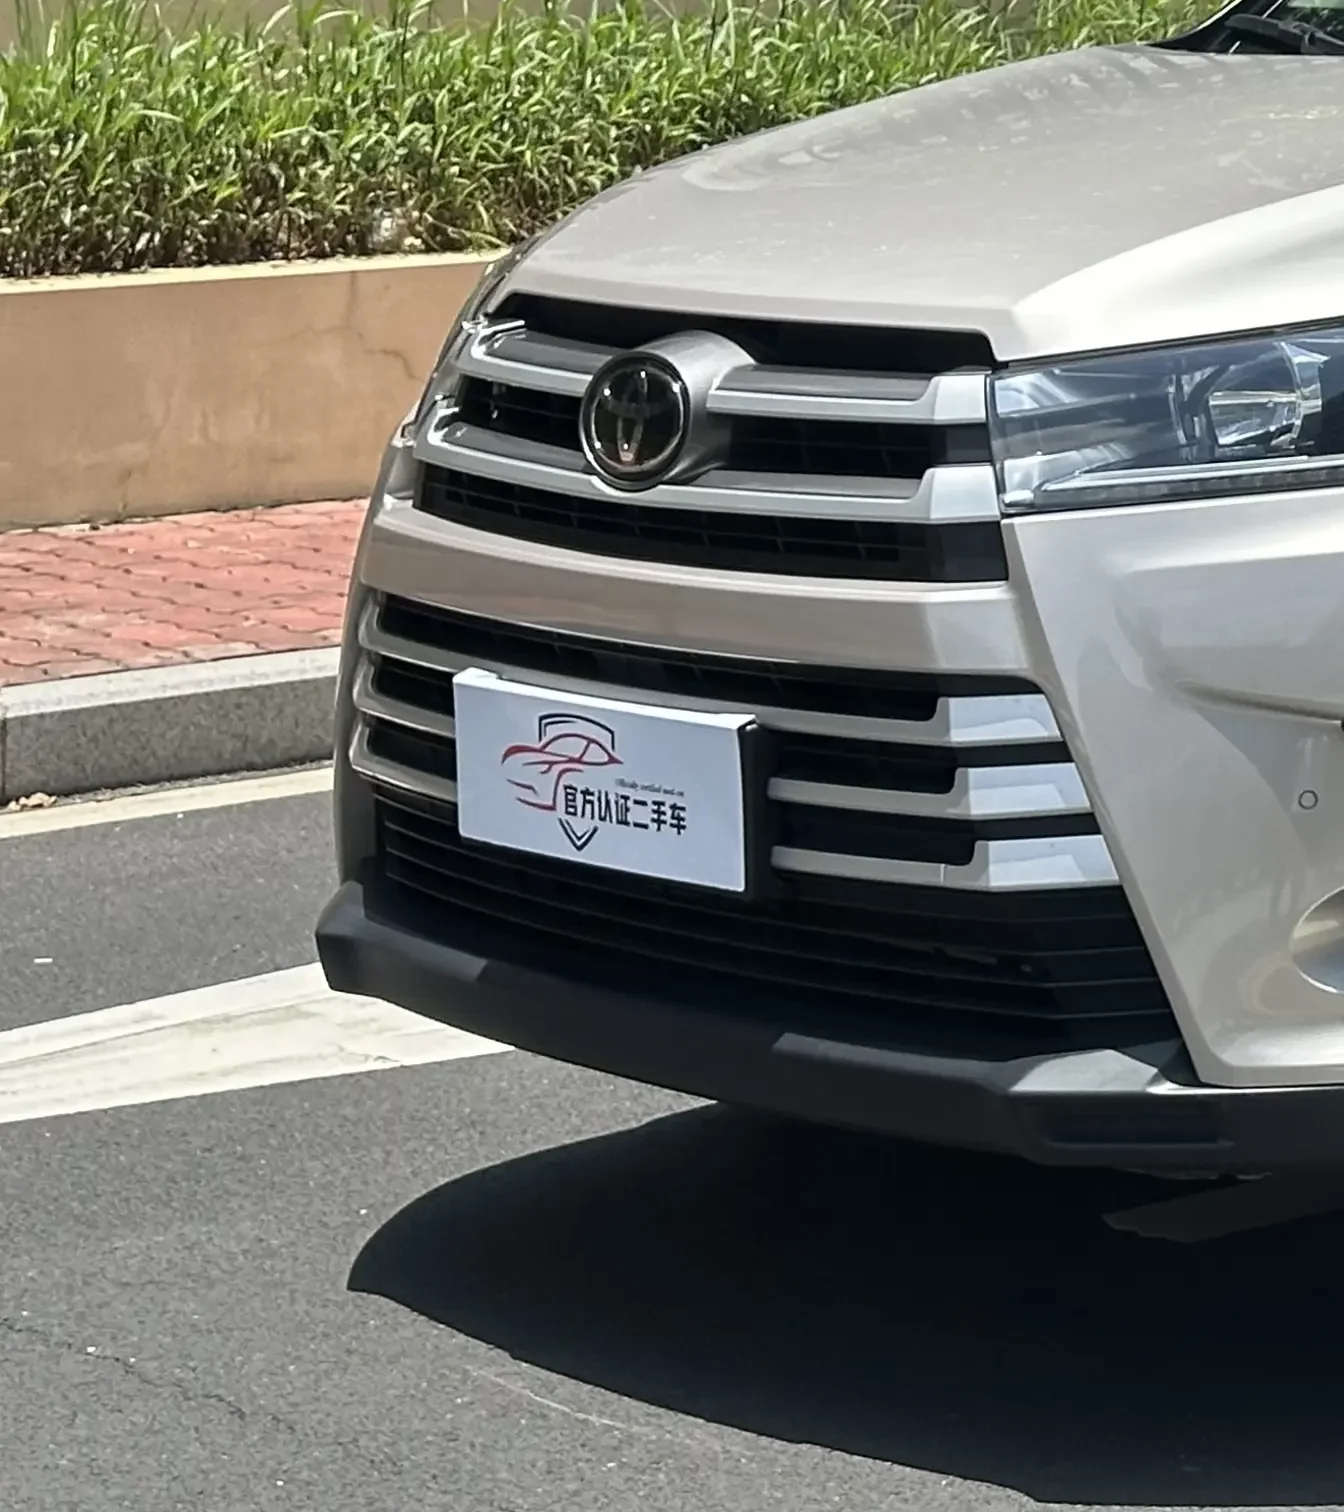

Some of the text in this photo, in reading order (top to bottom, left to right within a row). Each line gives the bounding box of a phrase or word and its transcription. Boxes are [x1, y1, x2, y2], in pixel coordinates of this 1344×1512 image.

[563, 784, 687, 835] 官方认证二手车
